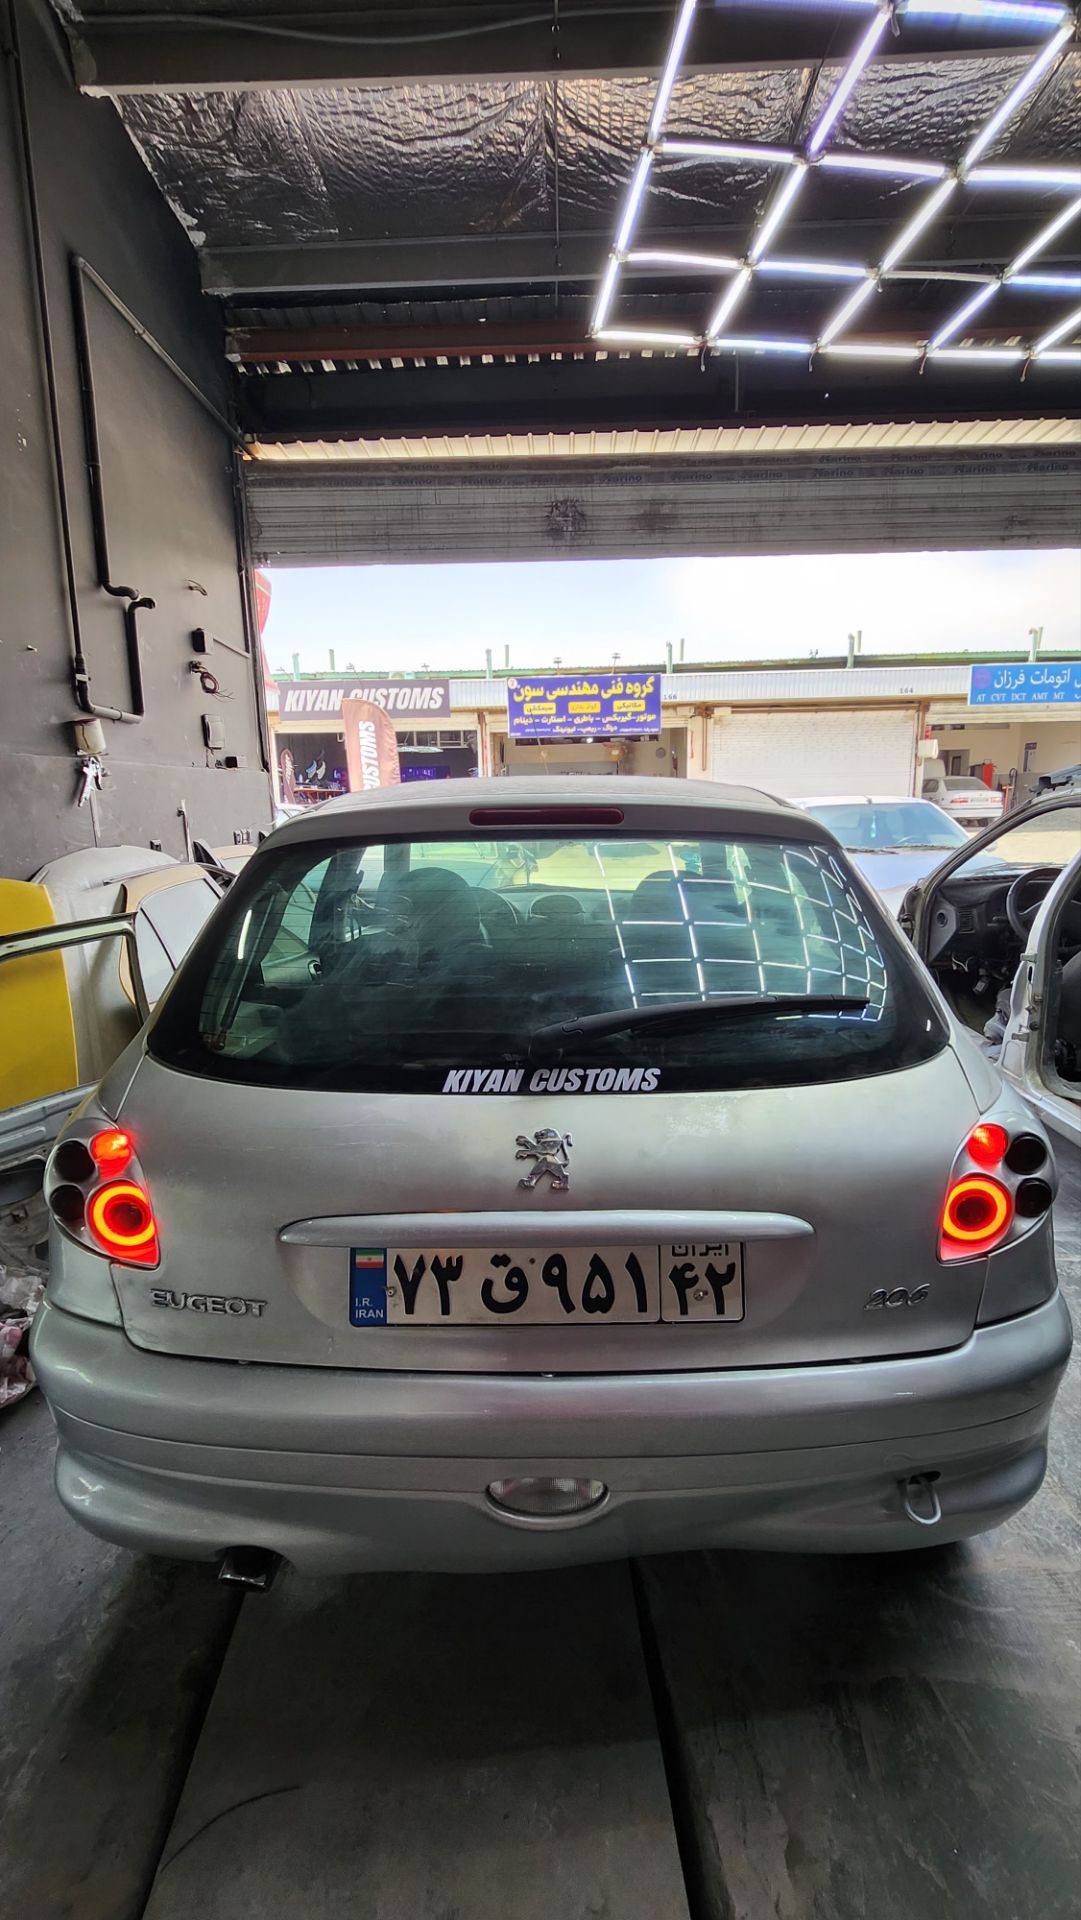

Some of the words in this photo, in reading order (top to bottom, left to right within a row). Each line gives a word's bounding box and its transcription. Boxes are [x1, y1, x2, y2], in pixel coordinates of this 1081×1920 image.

[601, 677, 624, 699] فنی
[625, 676, 656, 698] گروه
[994, 669, 1025, 689] فرزان
[1030, 668, 1071, 688] اتومات
[284, 689, 344, 712] KIYAN
[513, 684, 544, 702] سون
[546, 681, 599, 700] مهندسی
[442, 1069, 525, 1093] KIYAN
[529, 1068, 661, 1092] CUSTOMS
[150, 1288, 268, 1316] EUGEOT
[355, 1297, 373, 1307] I.R.
[863, 1283, 930, 1310] 206
[355, 1309, 384, 1319] IRAN
